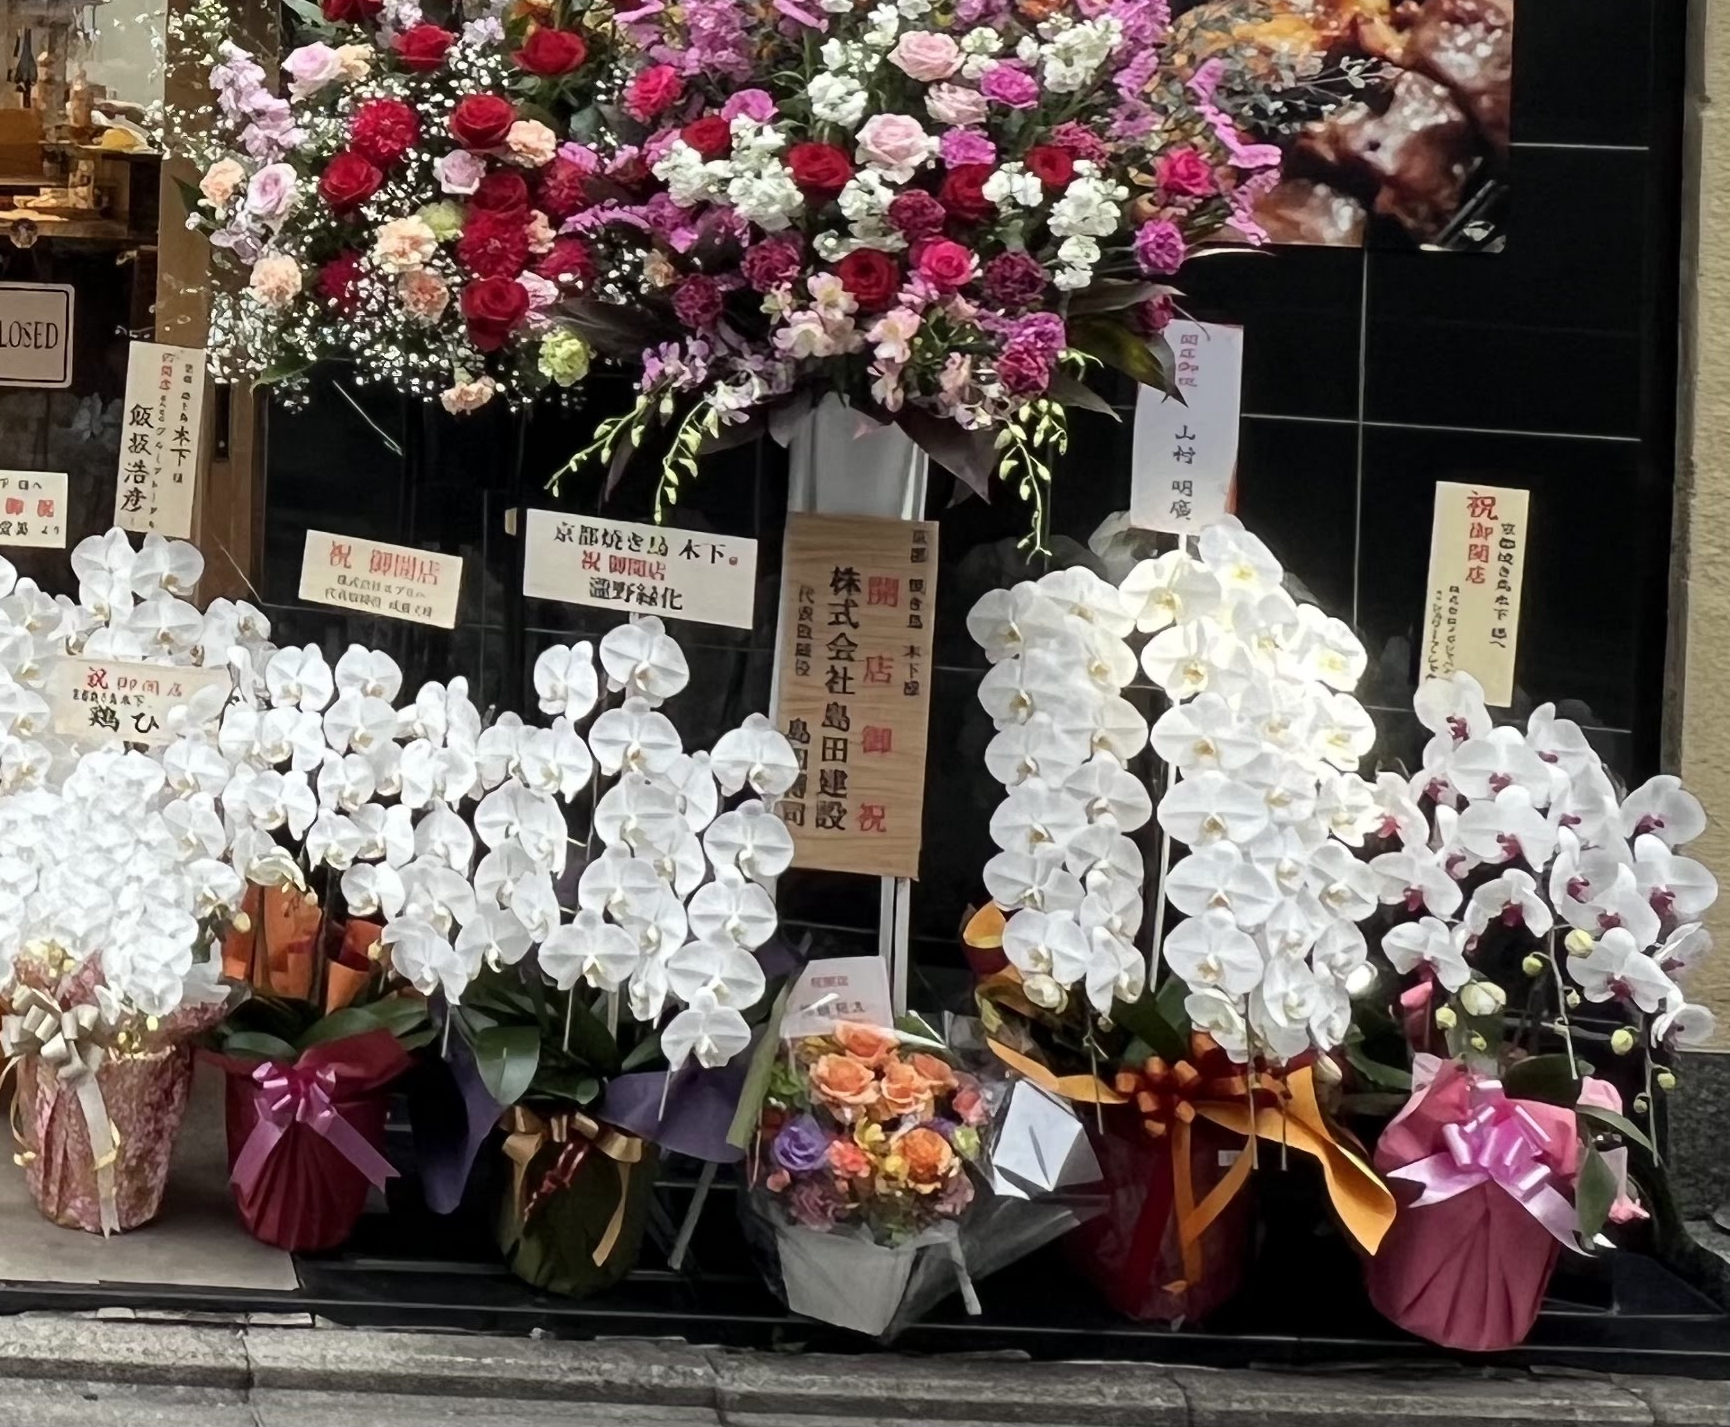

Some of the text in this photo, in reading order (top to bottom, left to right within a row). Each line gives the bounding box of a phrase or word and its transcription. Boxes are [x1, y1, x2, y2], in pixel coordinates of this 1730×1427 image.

[329, 539, 353, 571] 祝
[368, 547, 442, 587] 御開店
[580, 549, 667, 582] 祝 御開店
[678, 538, 728, 565] 木下
[87, 666, 110, 690] 祝
